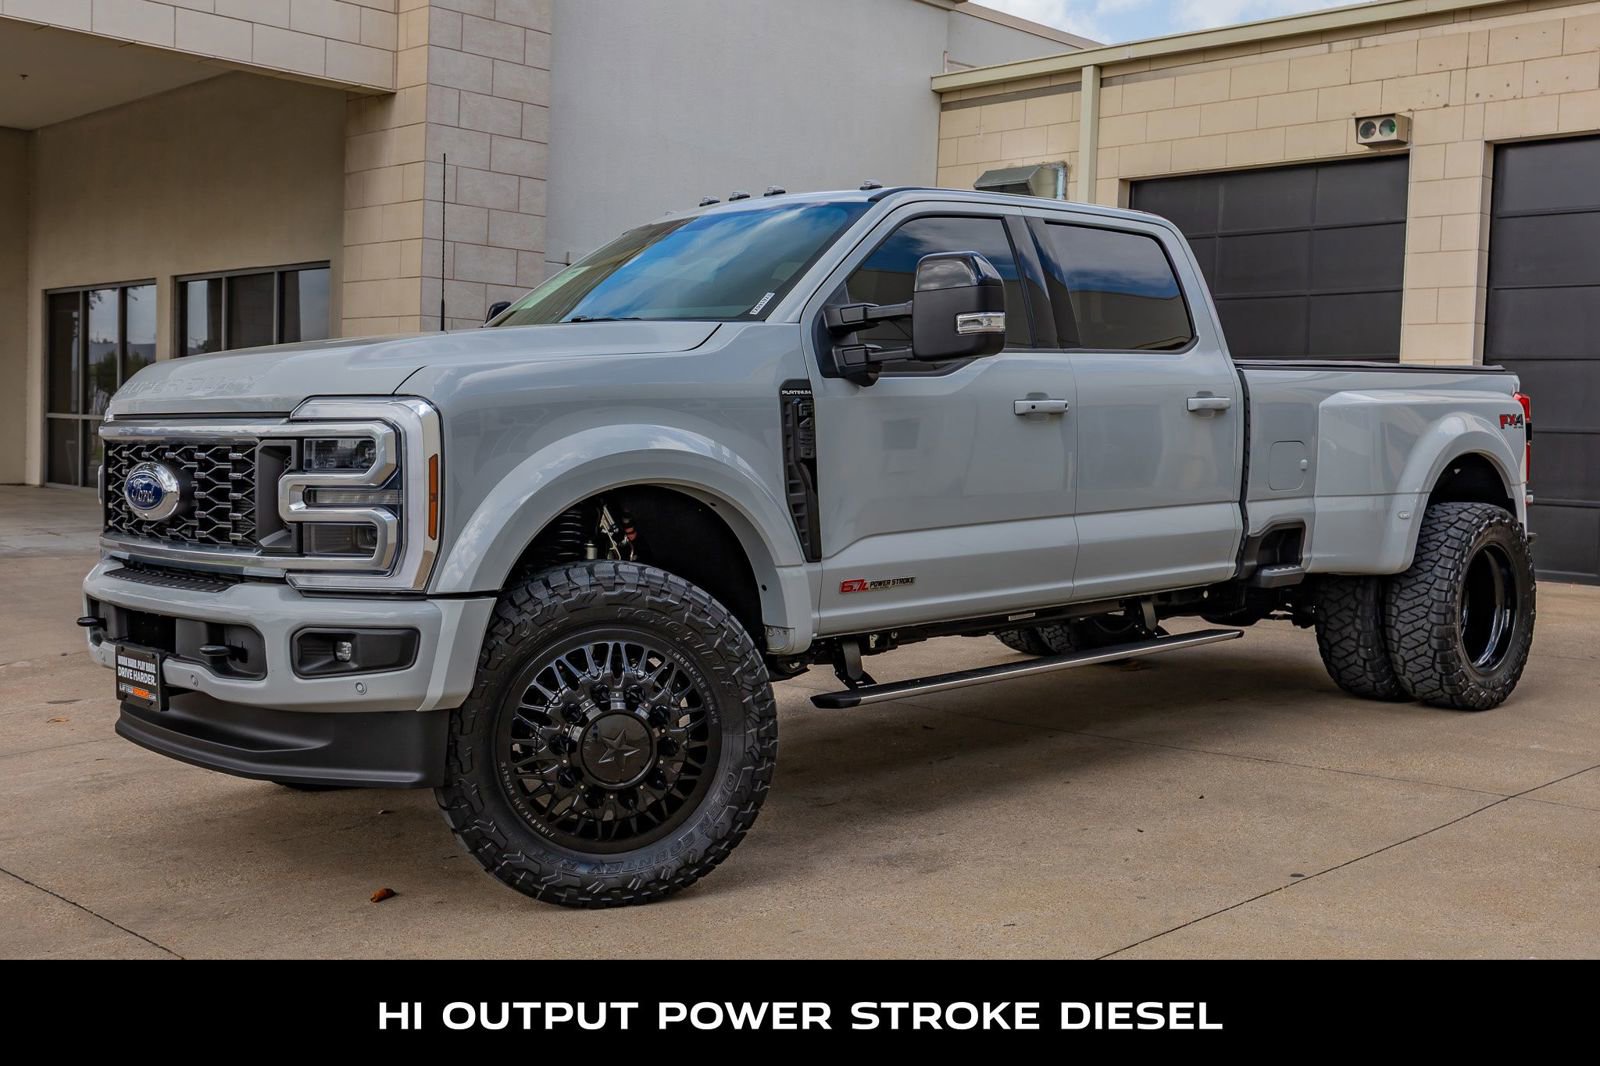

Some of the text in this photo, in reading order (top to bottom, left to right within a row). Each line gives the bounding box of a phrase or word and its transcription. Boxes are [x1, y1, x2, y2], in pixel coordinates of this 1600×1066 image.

[1499, 414, 1524, 429] FX4
[840, 579, 868, 593] 6.7L
[870, 579, 891, 587] POWER
[891, 577, 916, 586] STROKE
[118, 665, 133, 680] DRIVE
[133, 670, 157, 686] HARDER.
